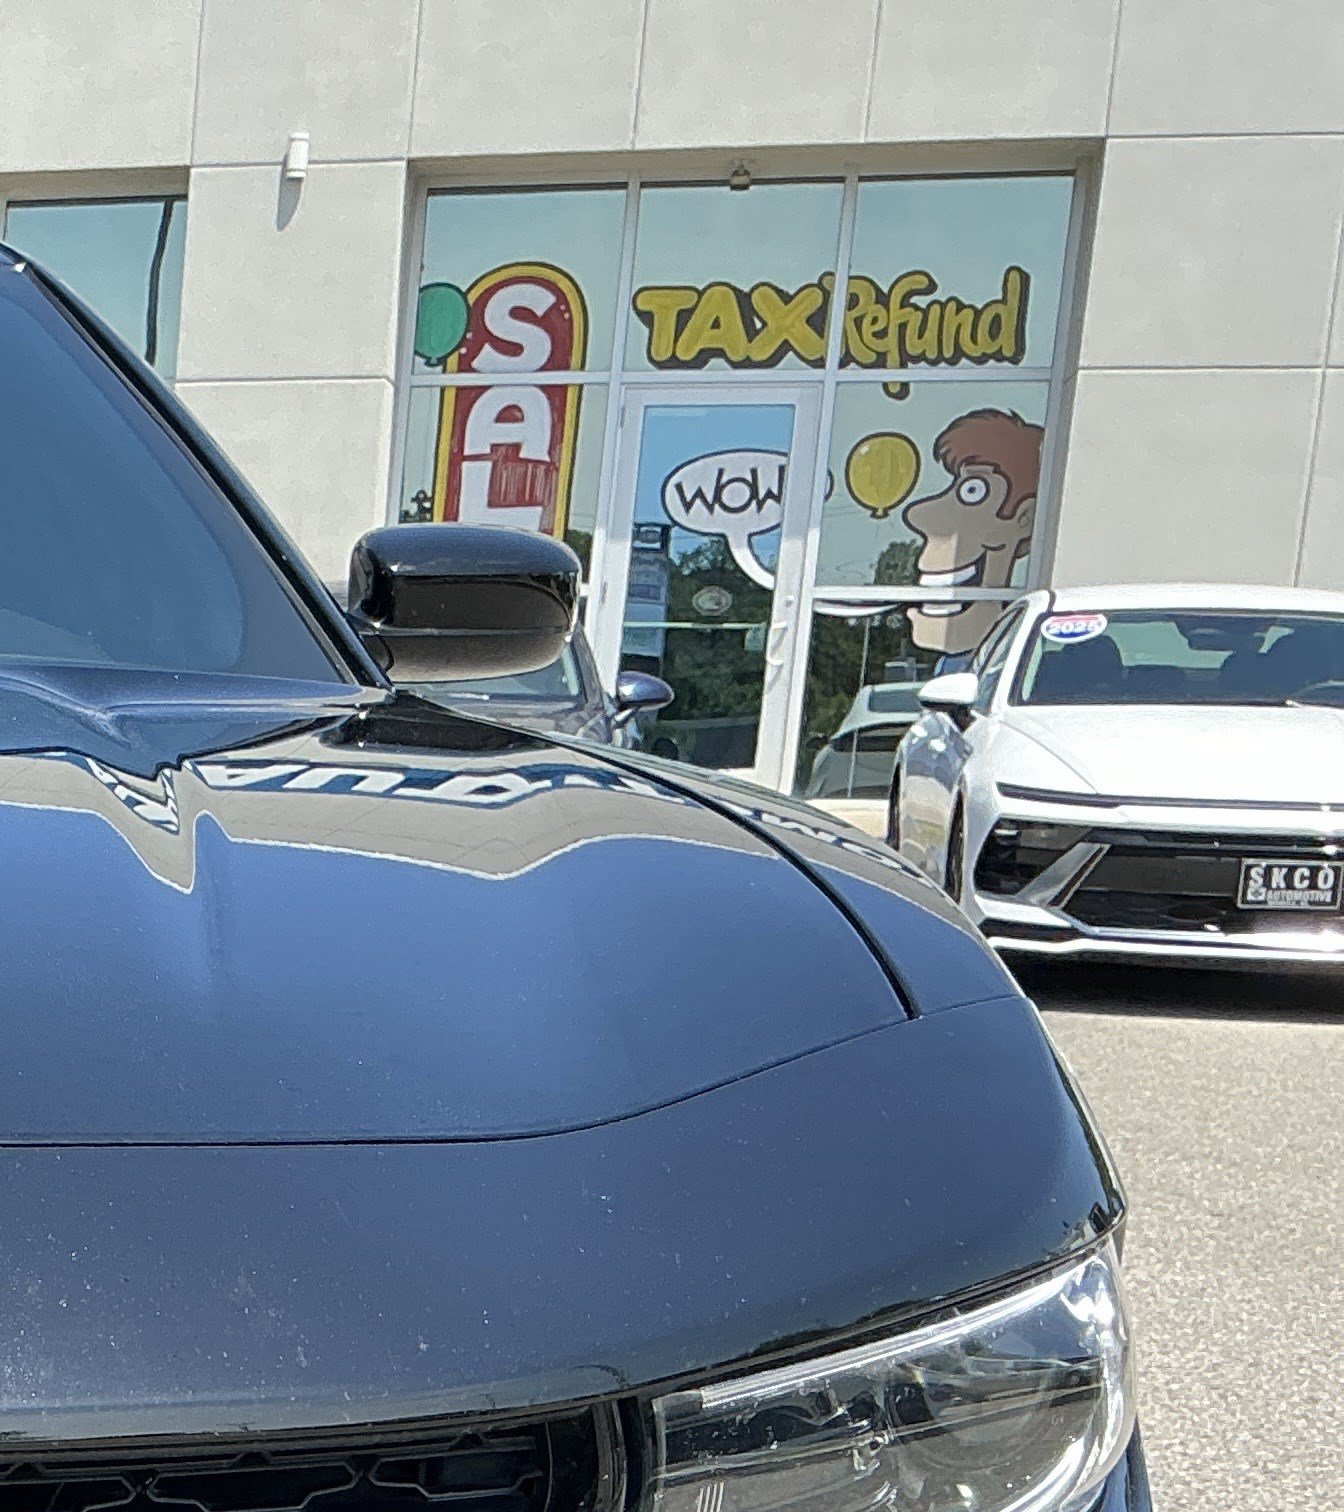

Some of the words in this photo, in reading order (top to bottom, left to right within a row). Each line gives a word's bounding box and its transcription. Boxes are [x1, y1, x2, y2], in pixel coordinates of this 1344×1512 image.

[633, 281, 828, 367] TAX
[818, 266, 1029, 400] Refund
[675, 465, 785, 515] WOW
